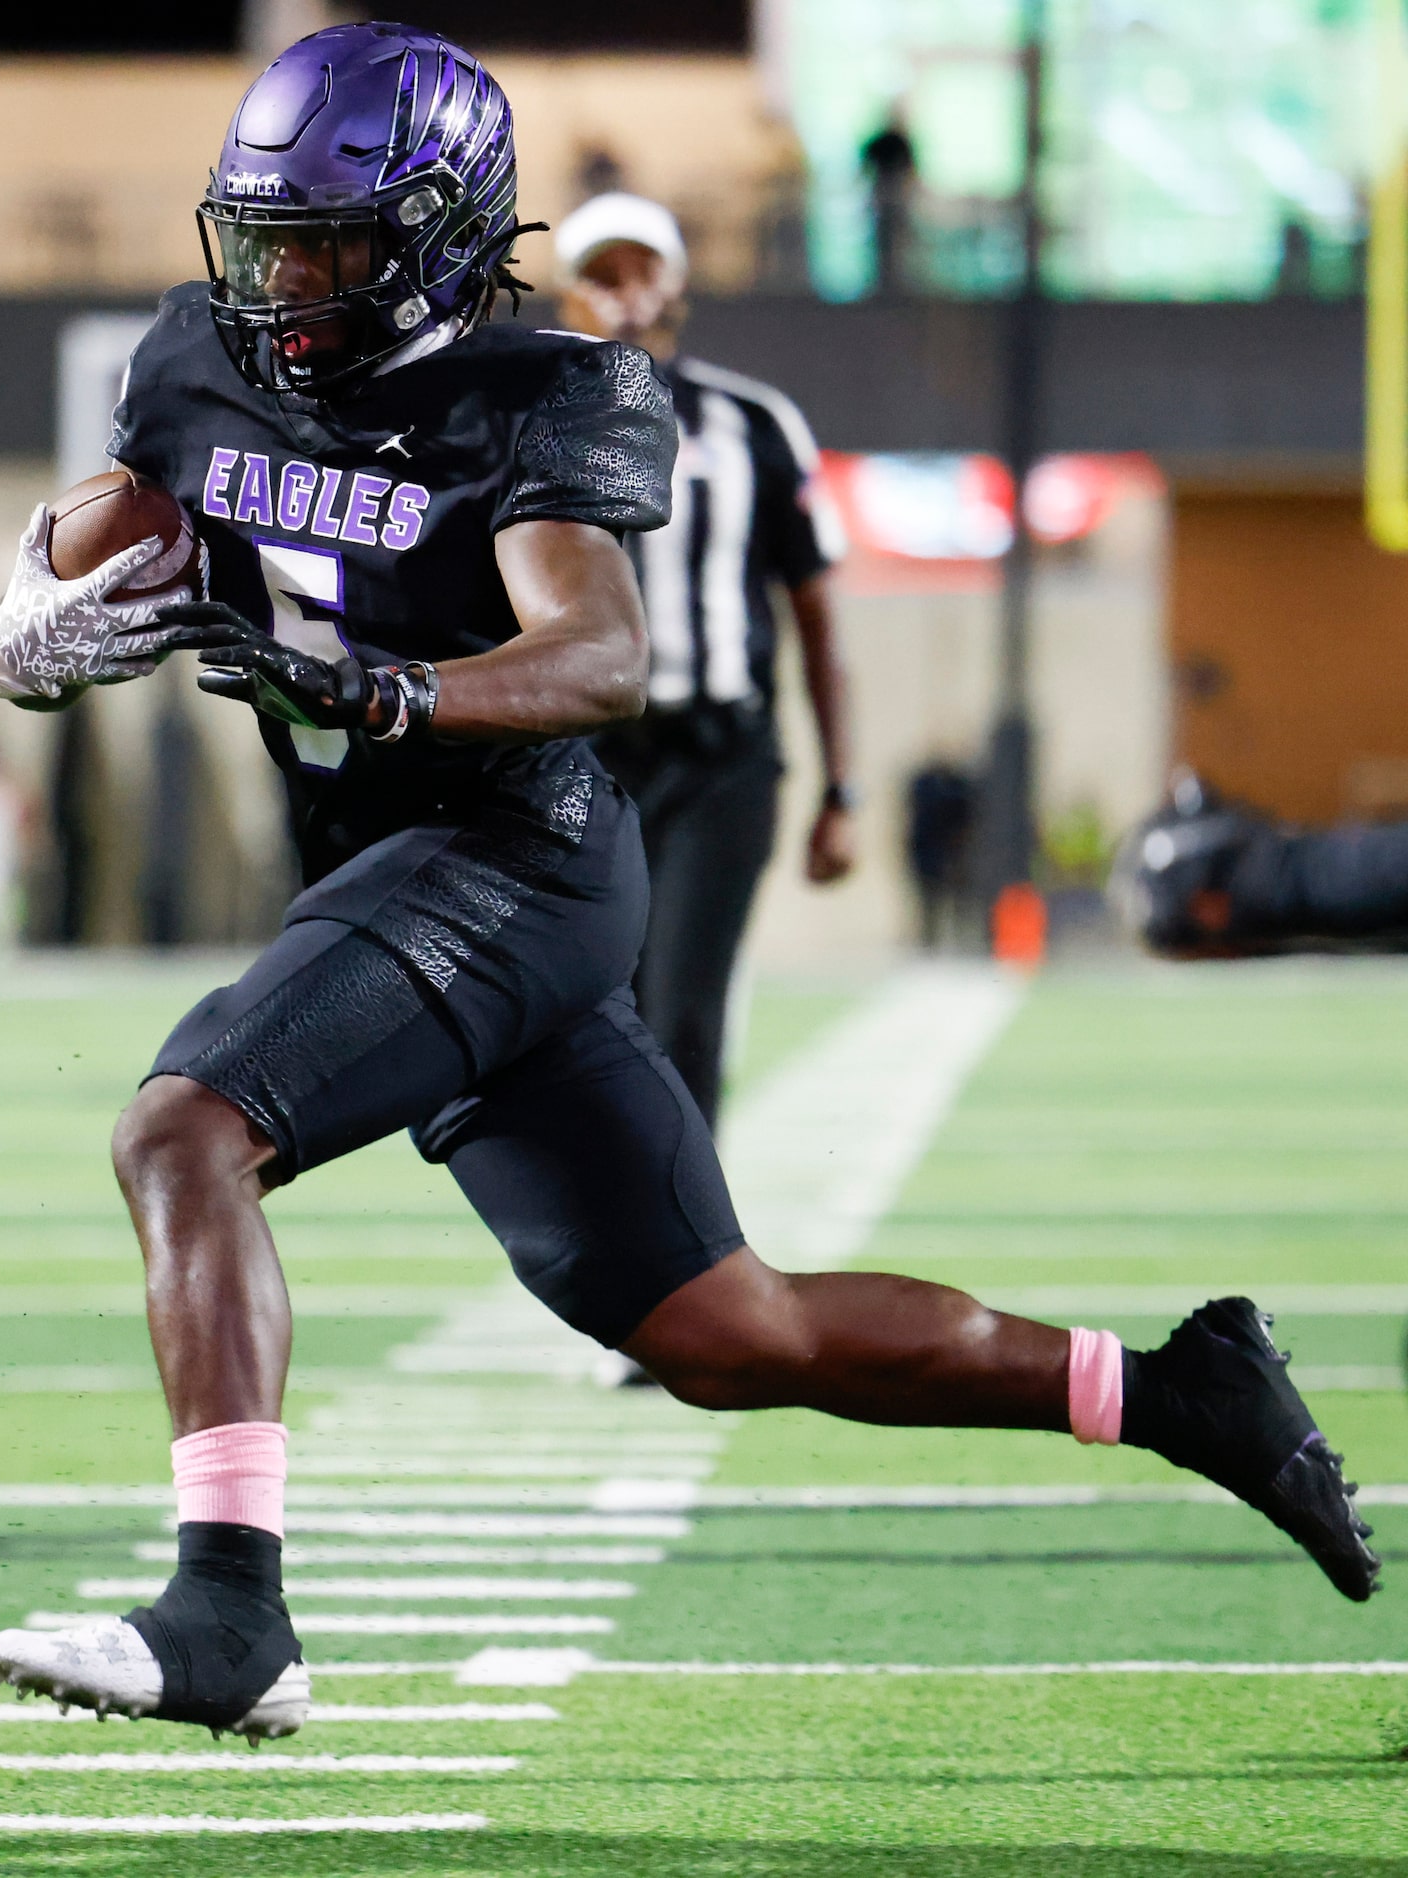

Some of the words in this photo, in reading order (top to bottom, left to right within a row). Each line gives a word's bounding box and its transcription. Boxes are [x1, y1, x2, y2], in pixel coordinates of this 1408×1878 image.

[226, 175, 282, 196] CROWLEY
[202, 447, 431, 551] EAGLES
[252, 534, 346, 776] 5
